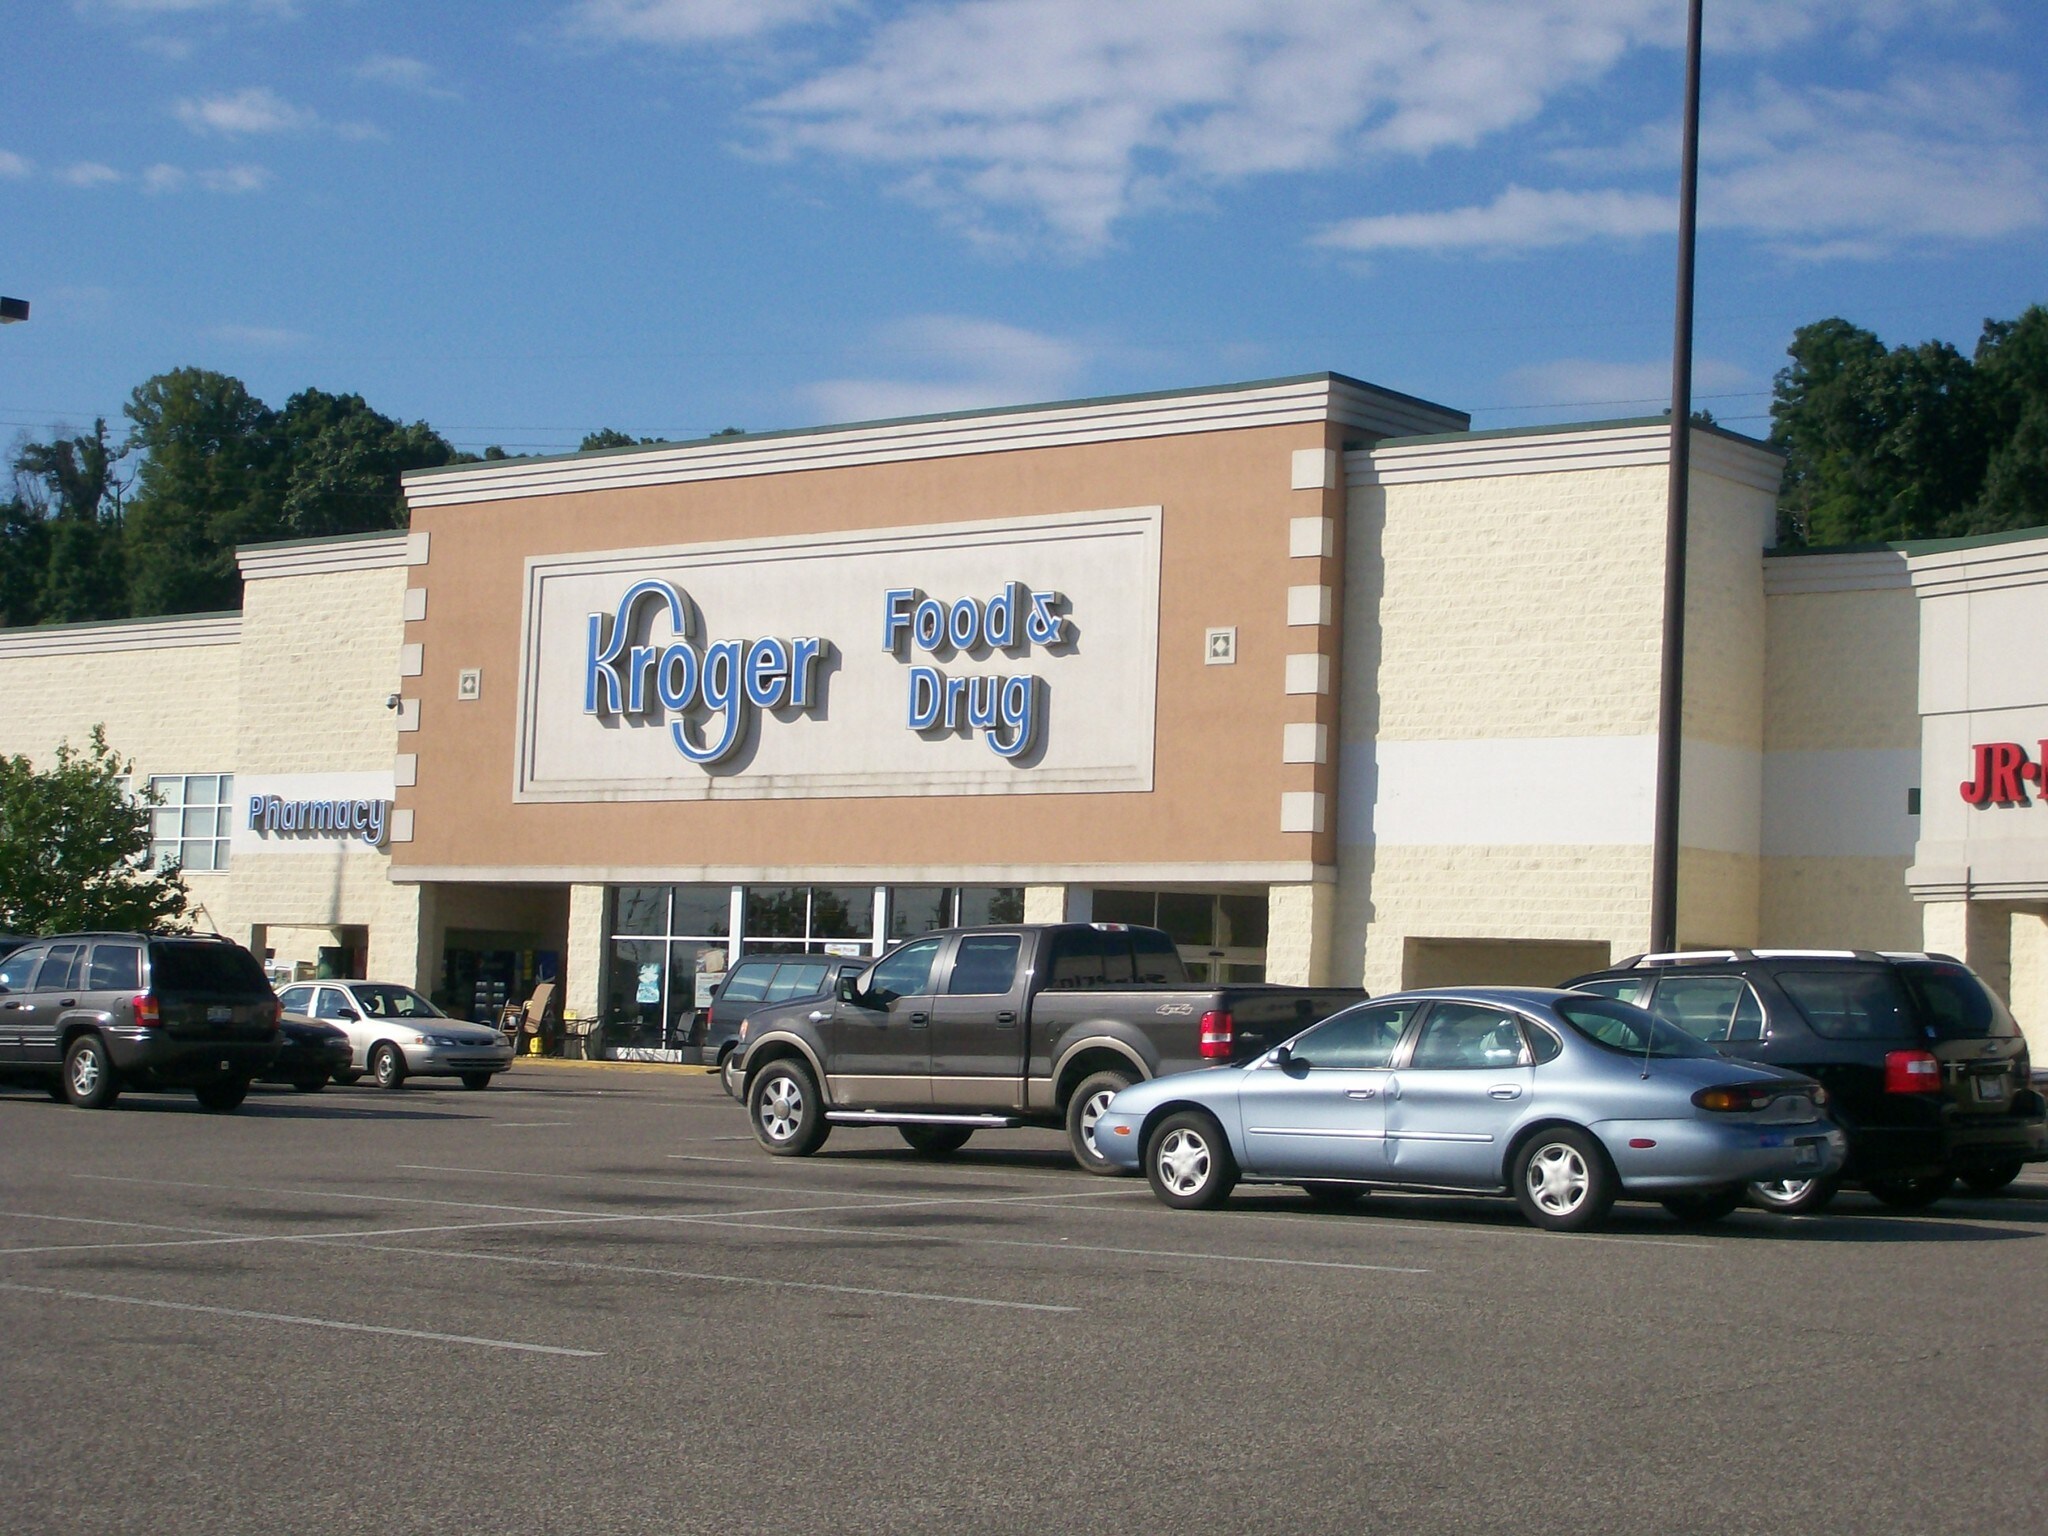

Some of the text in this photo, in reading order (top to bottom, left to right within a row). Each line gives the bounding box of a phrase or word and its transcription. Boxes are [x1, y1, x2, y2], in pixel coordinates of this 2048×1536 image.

[882, 580, 1066, 652] Food &
[583, 577, 826, 764] Kroger
[906, 665, 1036, 758] Drug
[247, 793, 387, 846] Pharmacy
